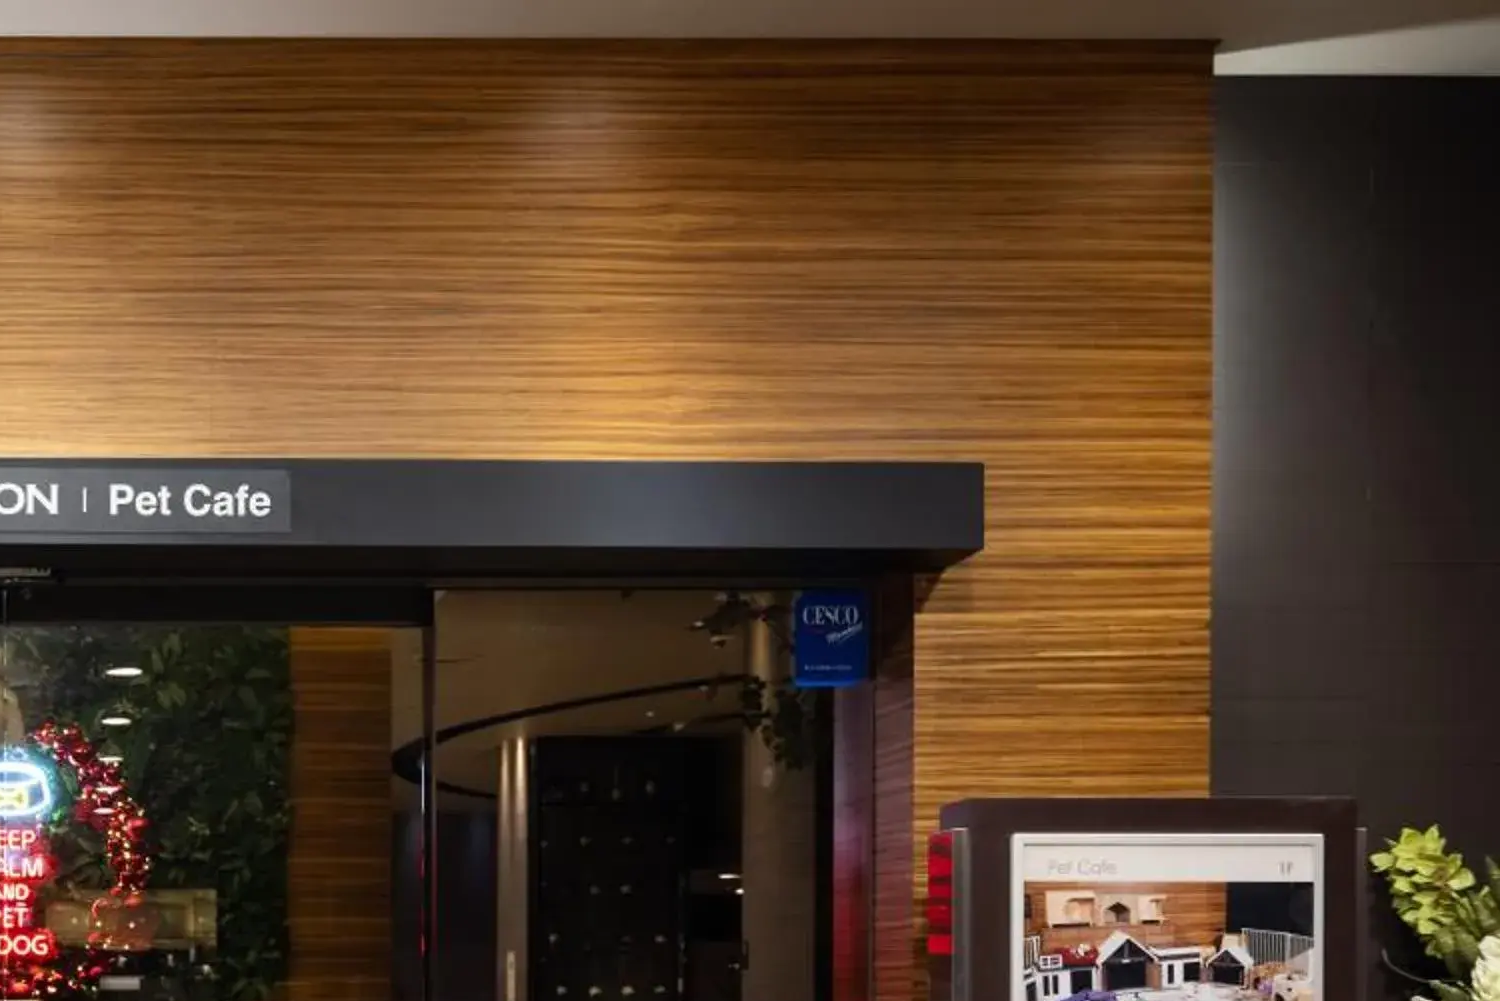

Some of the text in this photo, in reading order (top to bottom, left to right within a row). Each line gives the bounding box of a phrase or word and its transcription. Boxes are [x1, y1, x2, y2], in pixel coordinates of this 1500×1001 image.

[108, 483, 171, 516] Pet
[184, 483, 271, 517] Cafe
[802, 605, 860, 625] CESCO
[1047, 858, 1118, 876] Pet Cafe
